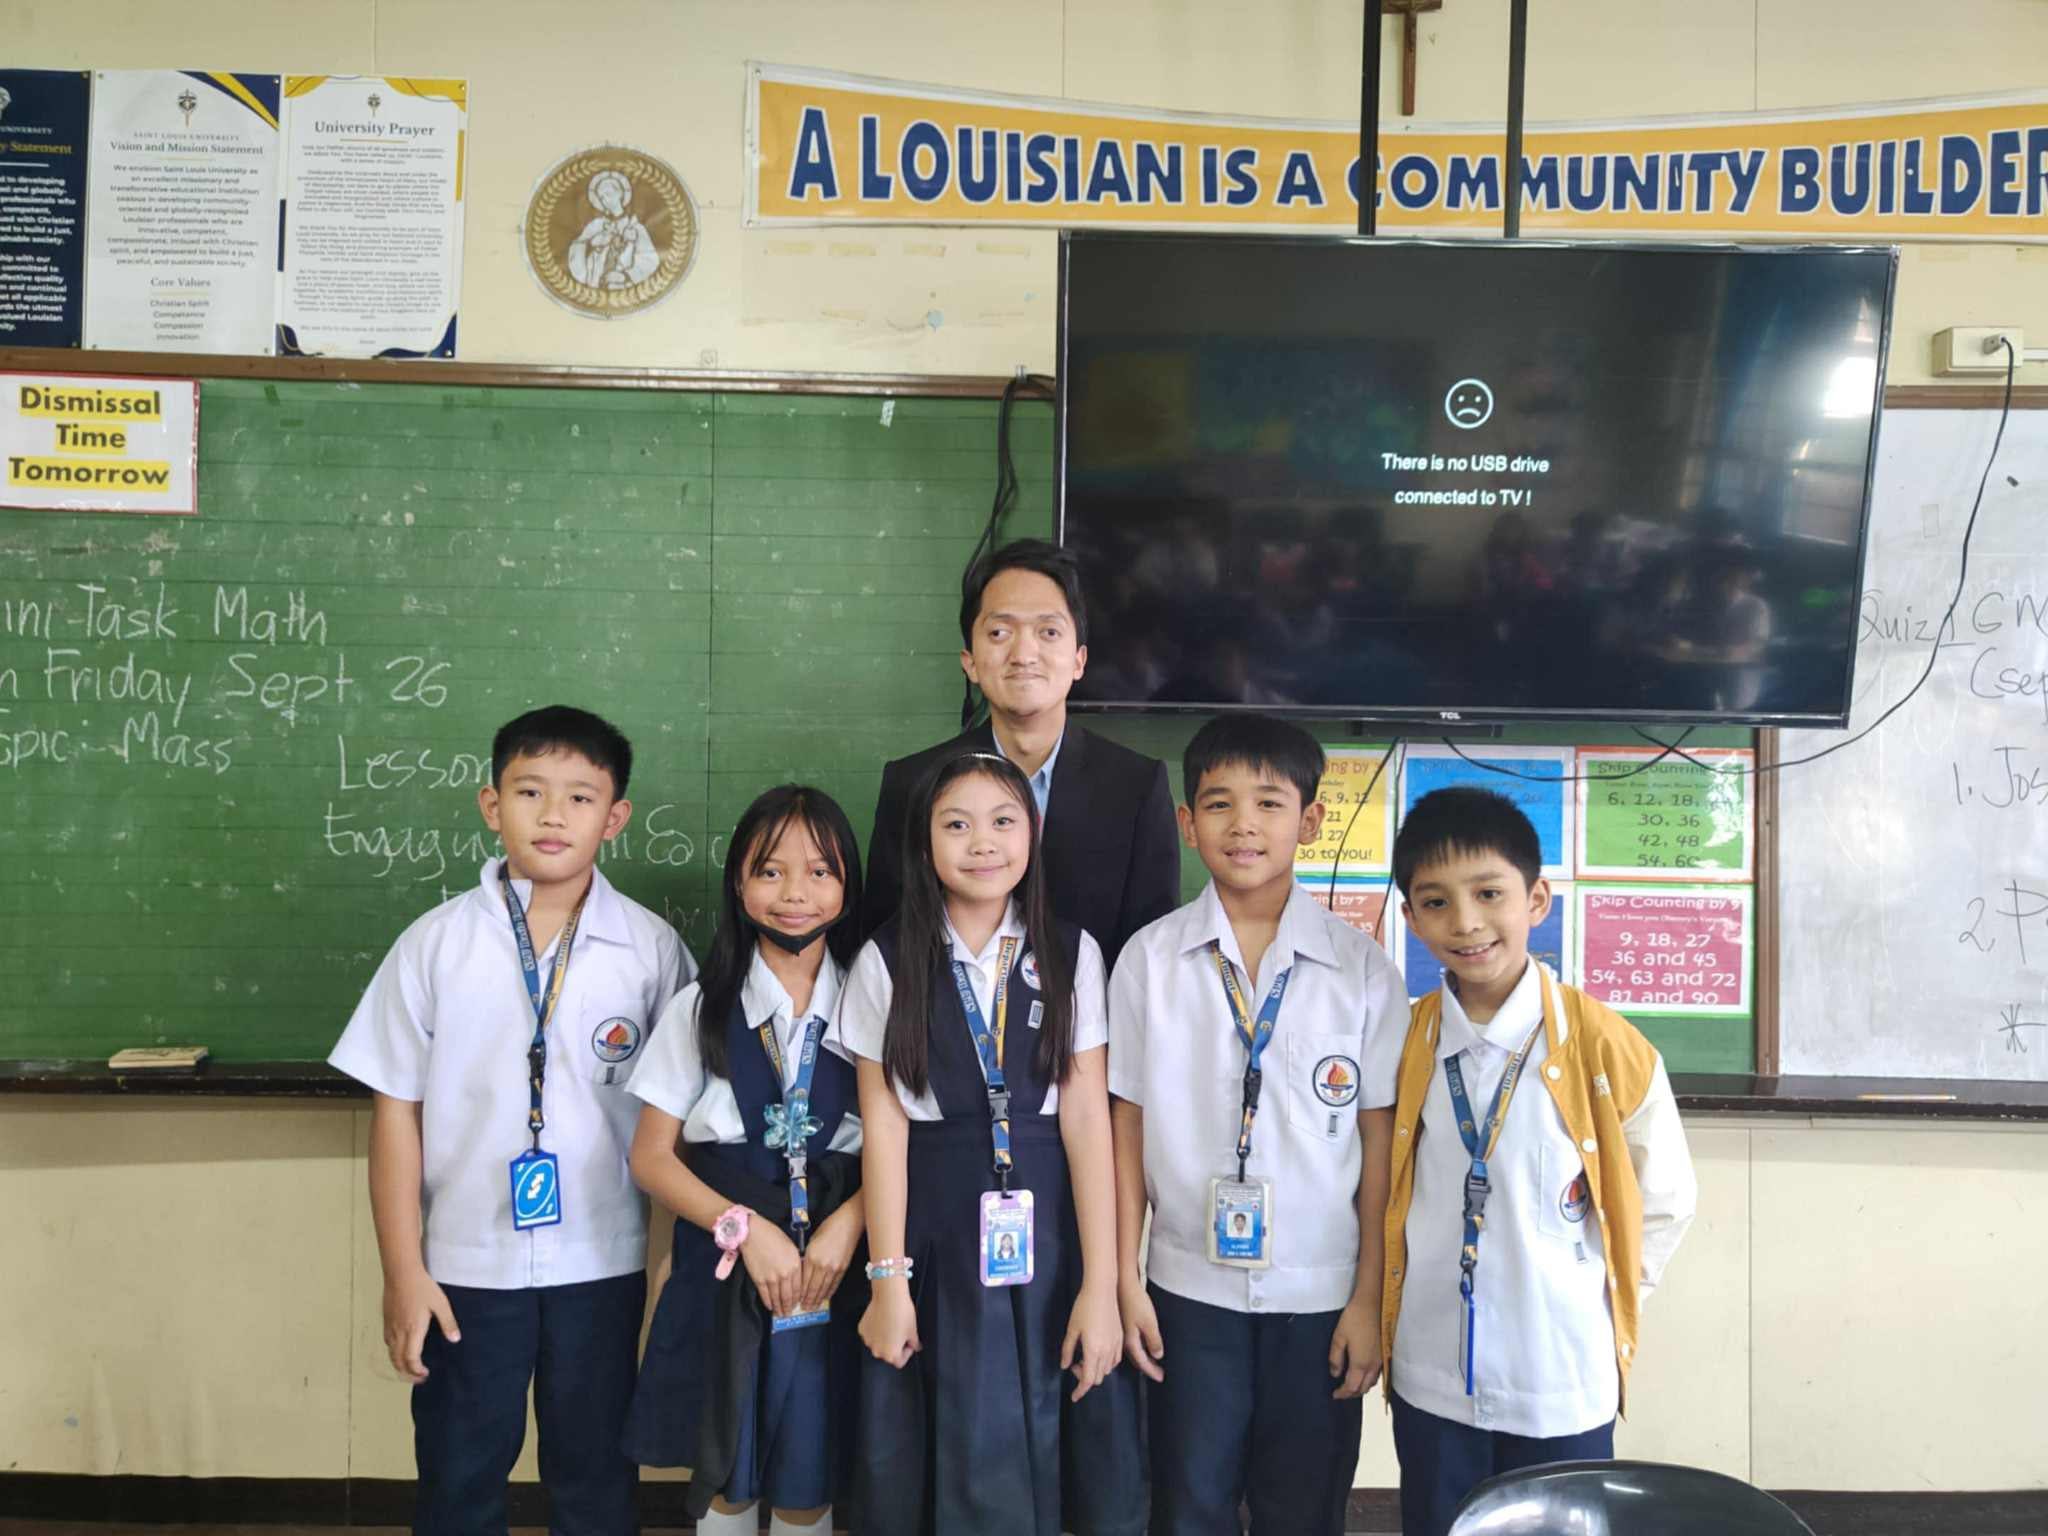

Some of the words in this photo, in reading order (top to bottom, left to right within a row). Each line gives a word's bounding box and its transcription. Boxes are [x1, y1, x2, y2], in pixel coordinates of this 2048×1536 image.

[314, 120, 385, 137] University
[389, 122, 435, 138] Prayer
[10, 142, 73, 154] Statement
[110, 141, 143, 151] Vision
[144, 142, 165, 152] and
[168, 142, 208, 153] Mission
[211, 144, 264, 155] Statement
[789, 108, 838, 200] A
[859, 116, 1183, 204] LOUISIAN
[1202, 148, 1258, 205] IS
[1276, 153, 1325, 206] A
[1347, 149, 1767, 214] COMMUNITY
[208, 166, 247, 175] University
[37, 216, 75, 224] Christian
[150, 277, 174, 287] Core
[177, 277, 211, 287] Values
[150, 299, 186, 307] Christian
[20, 386, 160, 415] Dismissal
[56, 423, 127, 449] Time
[1381, 452, 1428, 470] There
[1430, 454, 1445, 471] is
[1447, 457, 1468, 471] no
[1471, 454, 1508, 472] USB
[1510, 456, 1550, 473] drive
[8, 456, 169, 485] Tomorrow
[1394, 488, 1478, 505] connected
[1481, 490, 1497, 505] to
[1499, 489, 1523, 506] TV
[212, 585, 328, 646] Math
[44, 646, 192, 728] Friday
[225, 653, 354, 729] Sept
[385, 655, 452, 708] 26
[1440, 711, 1462, 720] TCL
[1598, 761, 1632, 776] Skip
[1326, 811, 1342, 822] 21
[1676, 815, 1700, 828] 36
[323, 801, 500, 881] Engagin
[1327, 830, 1344, 841] 27
[1676, 834, 1700, 848] 48
[1299, 848, 1316, 860] 30
[1320, 848, 1338, 860] to
[1340, 848, 1373, 861] you!
[1590, 895, 1625, 909] Skip
[1629, 895, 1706, 911] Counting
[1707, 898, 1728, 911] by
[1619, 931, 1640, 946] 9,
[1647, 932, 1678, 948] 18,
[1685, 934, 1712, 948] 27
[1611, 951, 1636, 966] 36
[1642, 950, 1686, 966] and
[1692, 953, 1717, 967] 45
[1631, 970, 1654, 985] 63
[1661, 970, 1704, 986] and
[1711, 972, 1737, 987] 72
[1641, 990, 1684, 1004] and
[1691, 991, 1719, 1005] 90
